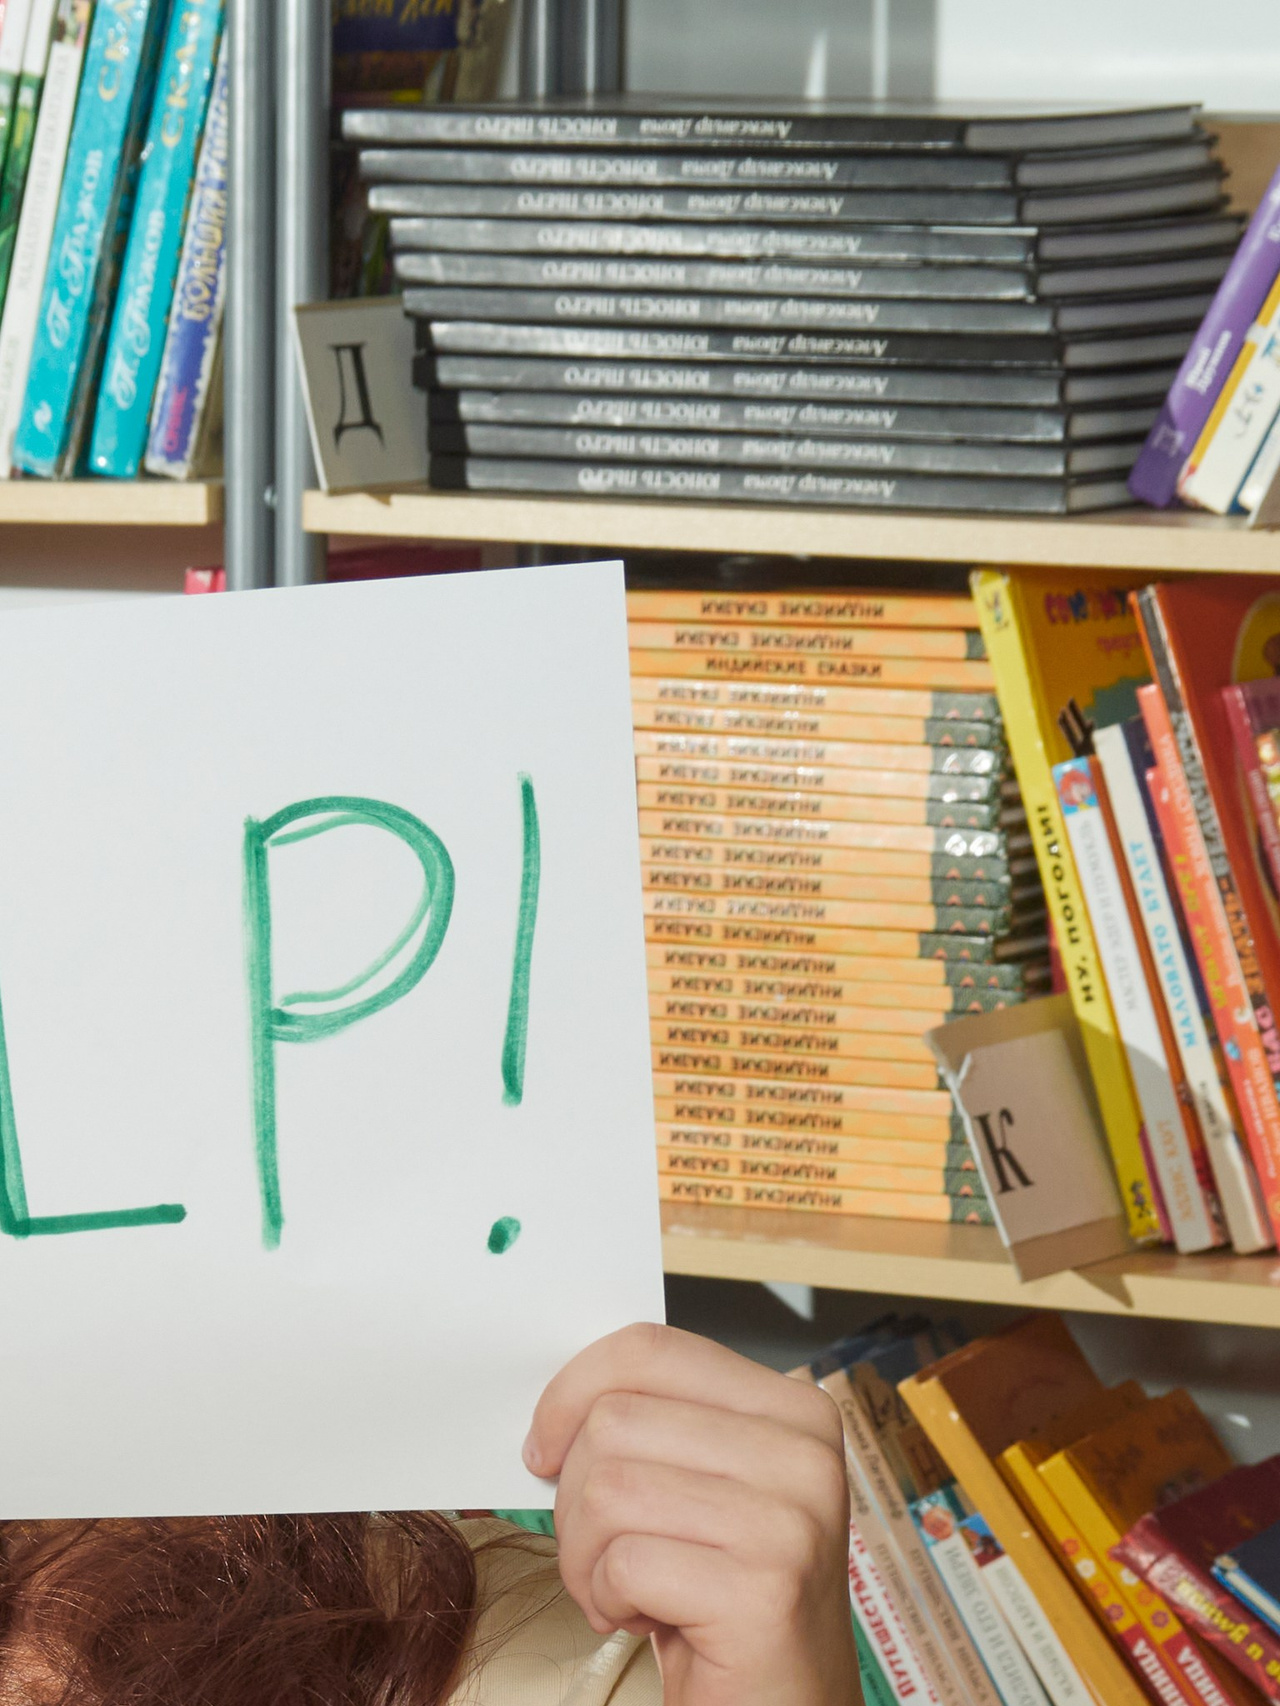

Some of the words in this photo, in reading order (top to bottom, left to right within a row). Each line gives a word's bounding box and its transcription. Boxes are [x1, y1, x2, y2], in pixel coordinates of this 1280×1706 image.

[475, 117, 533, 136] ПЬЕРО
[539, 118, 616, 136] ЮНОСТЬ
[640, 119, 691, 137] Дюма
[694, 117, 791, 138] Александр
[510, 158, 571, 177] ПЬЕРО
[576, 159, 656, 178] ЮНОСТЬ
[681, 160, 735, 179] Дюма
[739, 157, 838, 180] Александр
[556, 296, 614, 315] ПЬЕРО
[620, 298, 699, 317] ЮНОСТЬ
[724, 300, 777, 320] Дюма
[781, 298, 878, 322] Александр
[331, 343, 384, 448] Д
[579, 468, 636, 490] ПЬЕРО
[643, 470, 719, 491] ЮНОСТЬ
[744, 474, 796, 495] Дюма
[800, 474, 896, 498] Александр
[701, 600, 767, 615] СКАЗКИ
[675, 631, 739, 646] СКАЗКИ
[818, 663, 881, 679] СКАЗКИ
[650, 870, 712, 887] СКАЗКИ
[1037, 804, 1080, 945] ПОГОДИ!
[1128, 837, 1162, 913] БУДЕТ
[654, 920, 712, 936] СКАЗКИ
[1071, 954, 1097, 1004] НУ,
[1152, 923, 1200, 1048] МАЛОВАТО
[668, 1027, 728, 1043] СКАЗКИ
[660, 1053, 720, 1068] СКАЗКИ
[974, 1107, 1034, 1195] К
[669, 1156, 728, 1172] СКАЗКИ
[672, 1183, 732, 1199] СКАЗКИ
[938, 1544, 981, 1603] ЗВЕРИ
[967, 1597, 998, 1636] ЕГО
